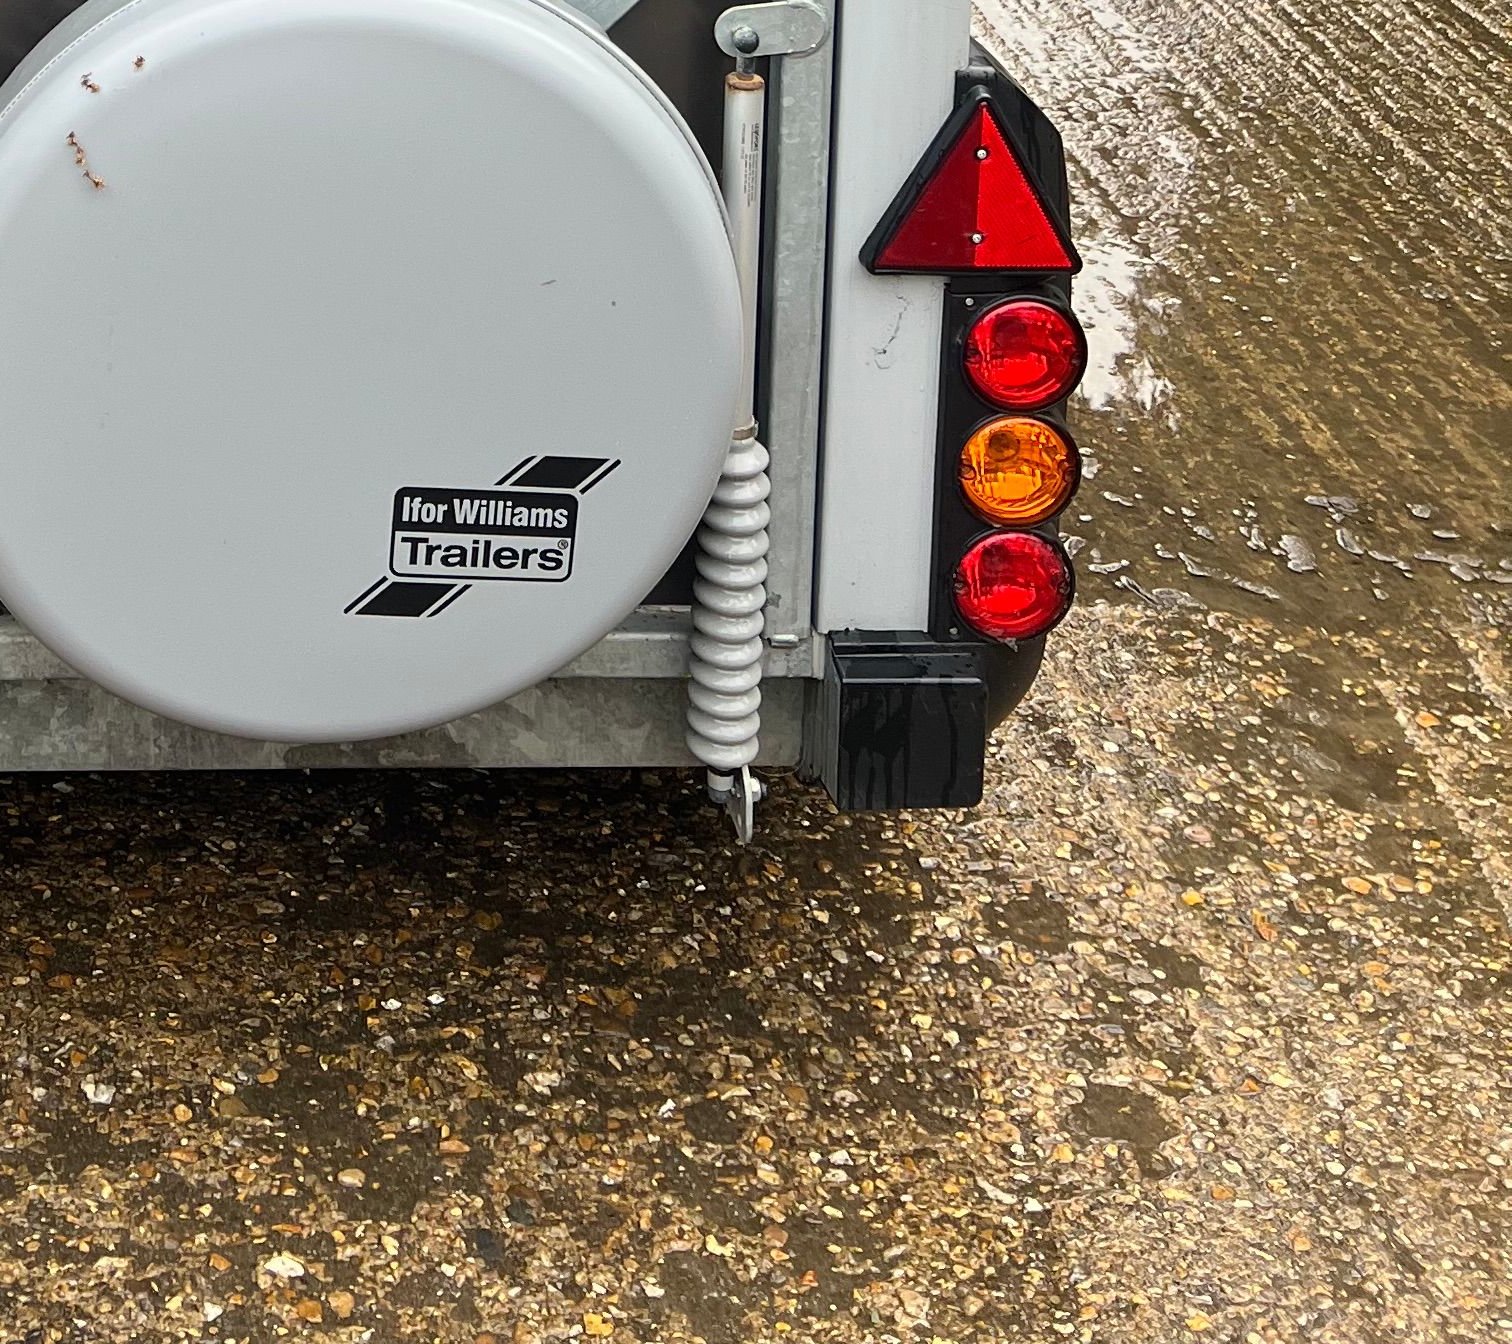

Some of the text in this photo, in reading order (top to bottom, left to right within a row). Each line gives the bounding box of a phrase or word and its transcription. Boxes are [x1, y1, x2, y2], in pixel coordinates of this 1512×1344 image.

[401, 496, 568, 529] Ifor Williams
[400, 536, 565, 571] Trailers
